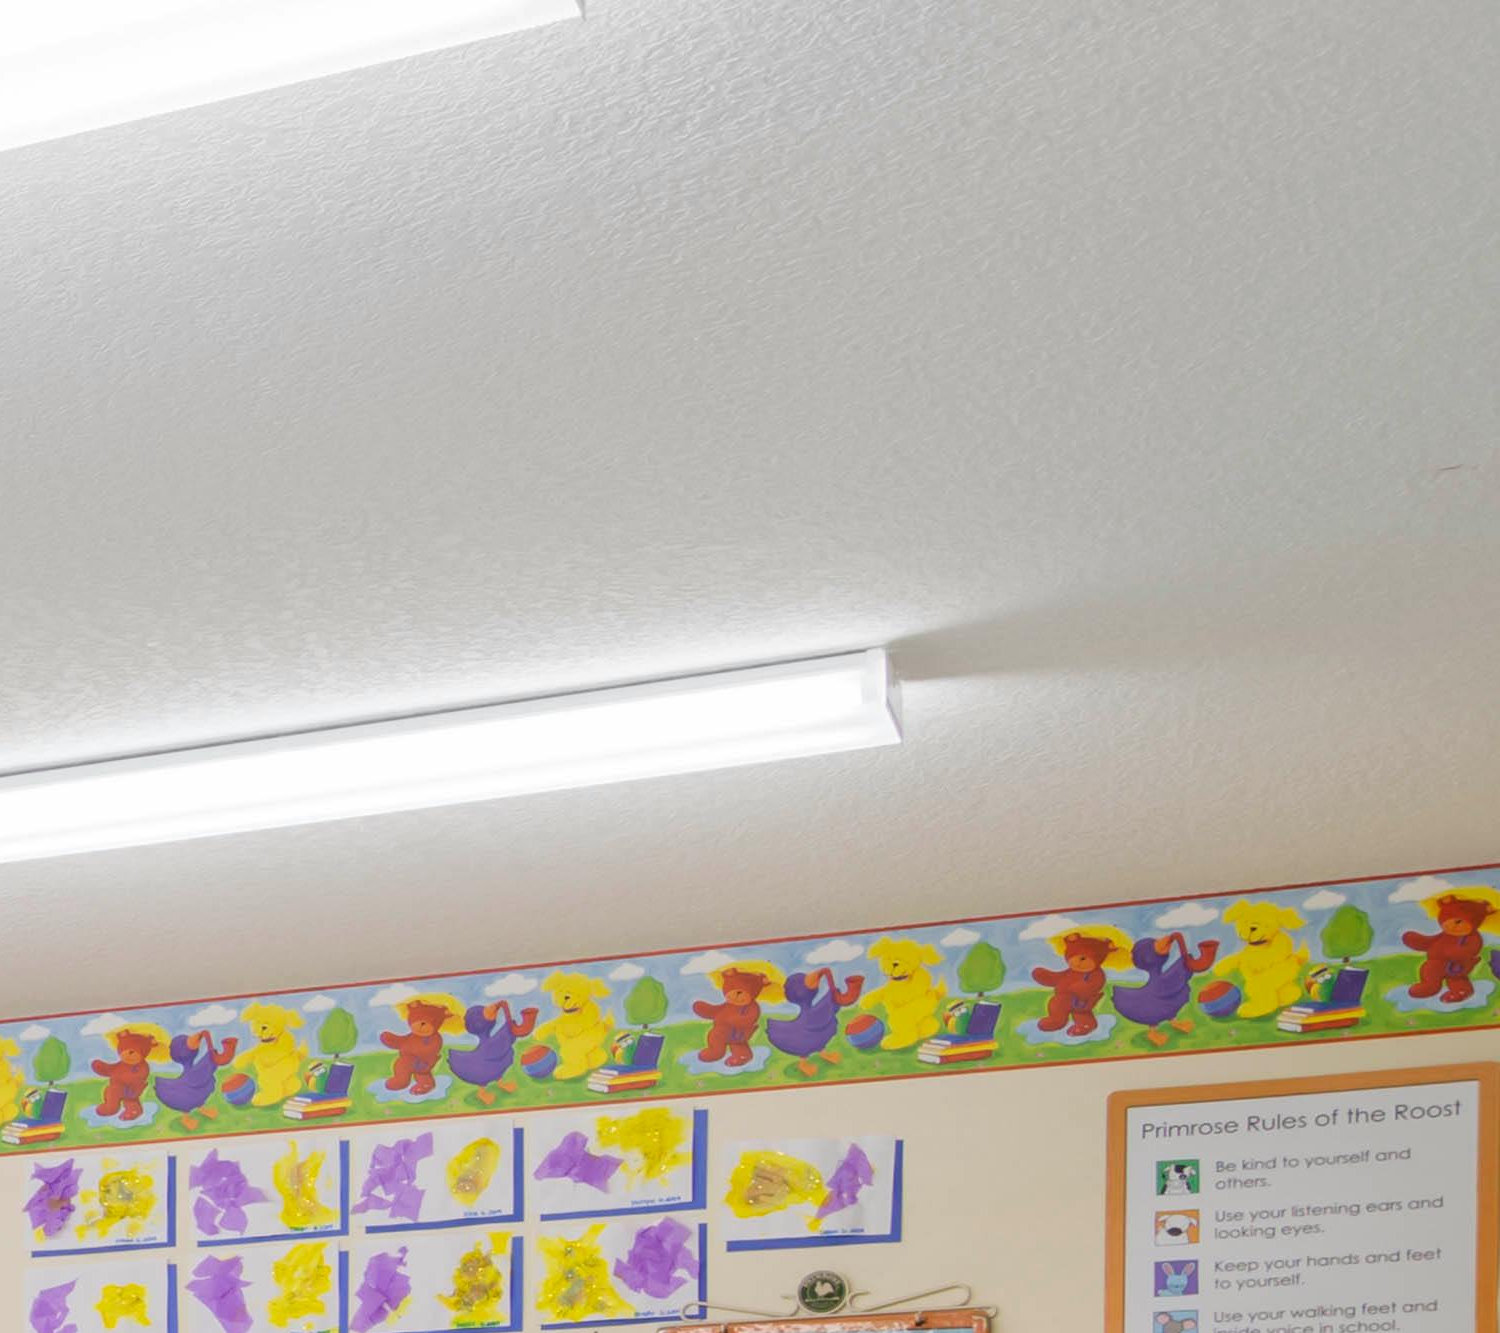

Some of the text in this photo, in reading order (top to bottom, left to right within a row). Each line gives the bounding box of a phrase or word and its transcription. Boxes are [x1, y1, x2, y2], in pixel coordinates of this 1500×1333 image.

[1141, 1100, 1461, 1140] Primrose Rules of the Roost
[1215, 1147, 1412, 1173] Be kind to yourself and
[1215, 1176, 1272, 1191] others.
[1215, 1196, 1444, 1224] Use your listening ears and
[1214, 1222, 1325, 1241] looking eyes.
[1214, 1247, 1442, 1275] Keep your hands and feet
[1214, 1273, 1306, 1292] to yourself.
[1213, 1299, 1439, 1324] Use your walking feet and
[1338, 1319, 1401, 1333] school.
